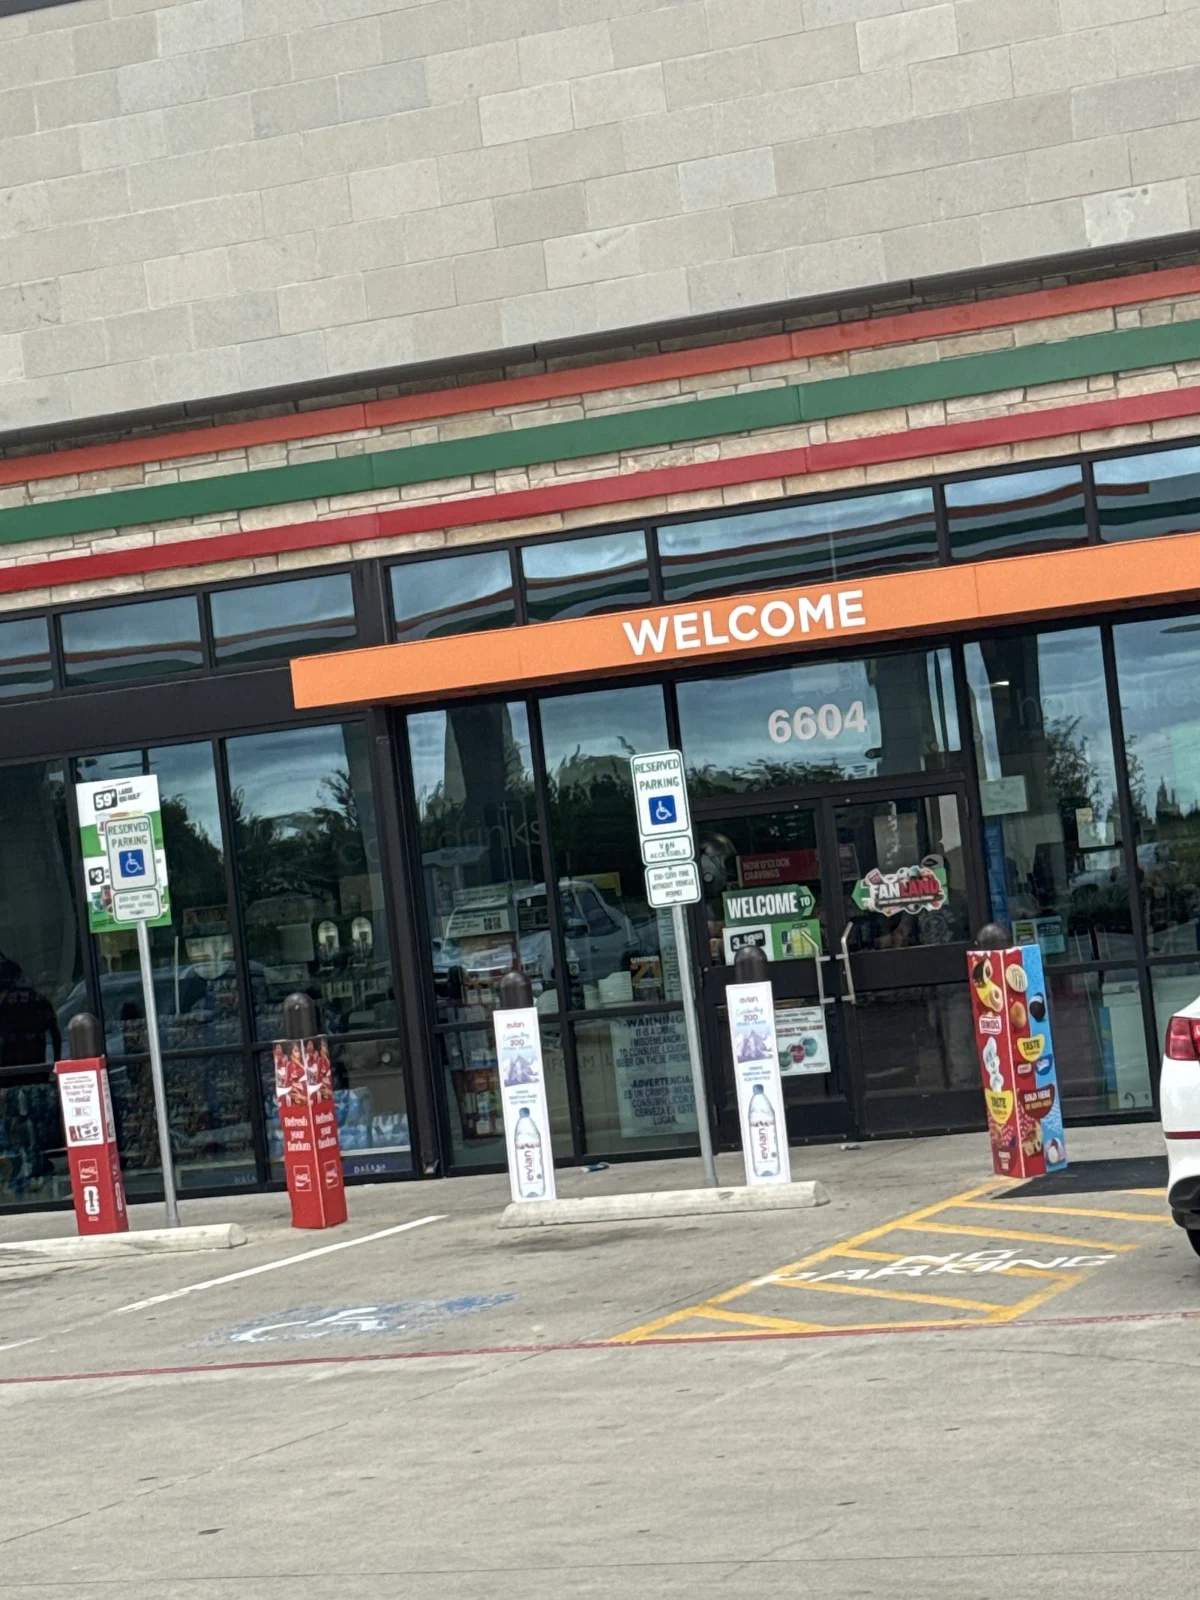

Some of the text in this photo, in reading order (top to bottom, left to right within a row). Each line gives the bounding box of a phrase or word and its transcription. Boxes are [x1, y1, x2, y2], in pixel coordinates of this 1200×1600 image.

[622, 590, 867, 656] WELCOME
[768, 701, 867, 744] 6604
[634, 759, 680, 774] RESERVED
[639, 776, 680, 791] PARKING
[107, 821, 149, 836] RESERVED
[111, 834, 148, 848] PARKING
[659, 841, 676, 850] VAN
[650, 848, 688, 859] ACCESSIBLE
[744, 869, 780, 880] CRAVINGS
[869, 874, 941, 900] FANLAND
[726, 892, 811, 919] WELCOME TO
[732, 937, 741, 949] 3
[630, 962, 663, 984] 21
[740, 996, 759, 1004] evian
[743, 1014, 759, 1022] 200
[506, 1021, 525, 1029] evian
[619, 1048, 628, 1058] TO
[629, 1045, 660, 1057] CONSUME
[1023, 1039, 1041, 1051] TASTE
[991, 1097, 1007, 1109] TASTE
[315, 1111, 334, 1125] Refresh
[635, 1106, 666, 1117] CERVEZA
[284, 1116, 308, 1127] Refresh
[290, 1130, 305, 1141] your
[320, 1125, 331, 1138] your
[287, 1140, 311, 1152] fandom
[318, 1136, 337, 1149] fandom
[758, 1127, 768, 1160] evian
[523, 1150, 534, 1181] evian
[888, 1248, 1024, 1268] NO
[750, 1254, 1117, 1285] PARKING
